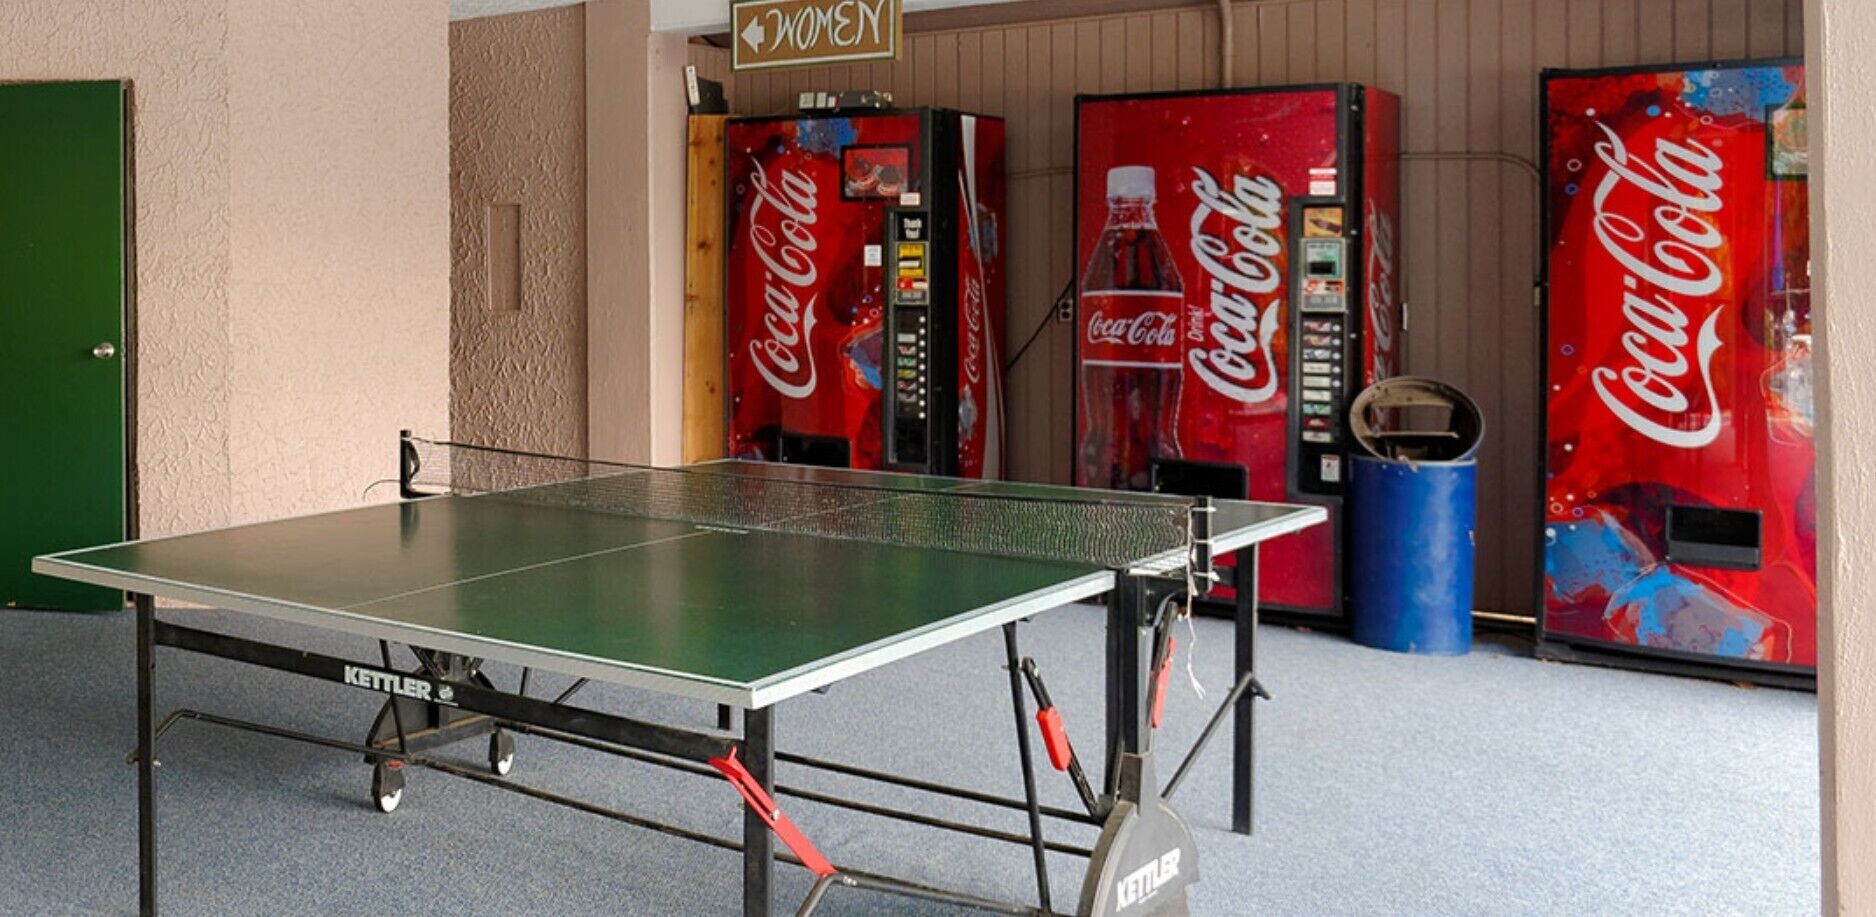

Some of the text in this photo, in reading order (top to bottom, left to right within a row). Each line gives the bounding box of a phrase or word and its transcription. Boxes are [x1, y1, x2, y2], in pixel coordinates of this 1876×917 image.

[766, 0, 884, 52] WOMEN
[750, 156, 817, 398] Coca-Cola
[1188, 166, 1281, 403] Coca-Cola
[1593, 120, 1723, 448] Coca-Cola
[1088, 310, 1177, 345] Coca-Cola
[344, 665, 431, 700] KETTLER
[1116, 847, 1181, 912] KETTLER
